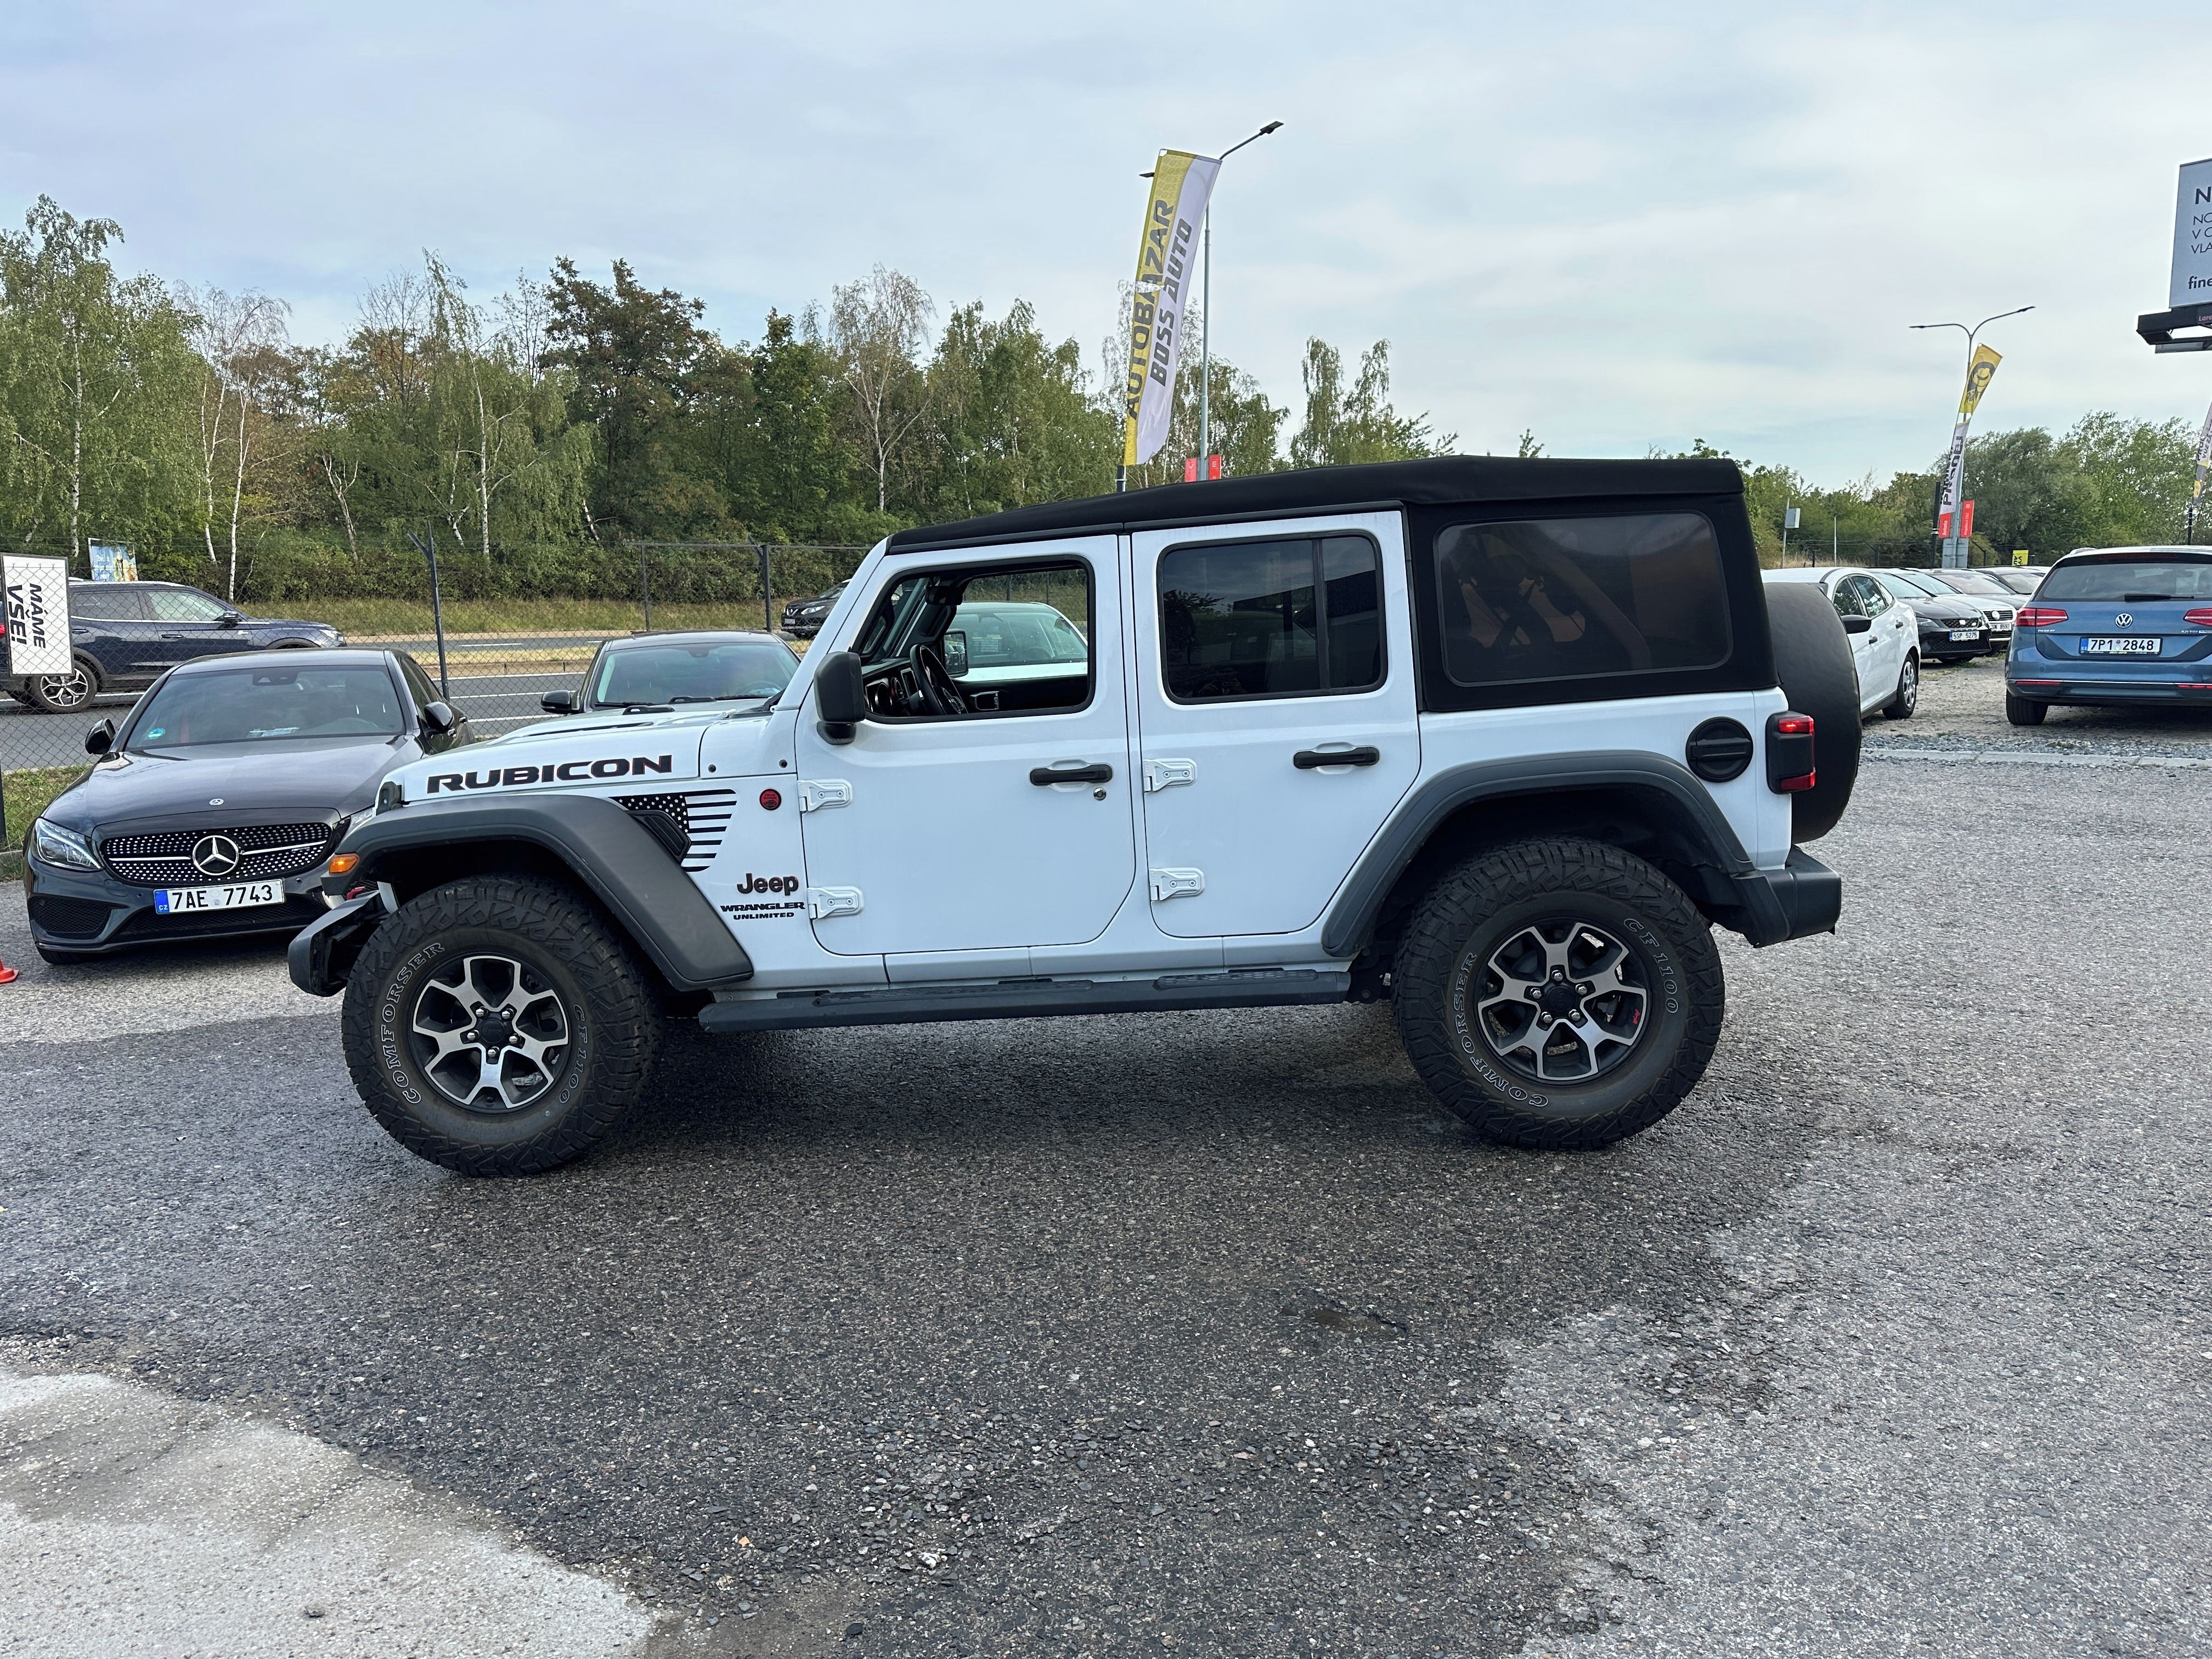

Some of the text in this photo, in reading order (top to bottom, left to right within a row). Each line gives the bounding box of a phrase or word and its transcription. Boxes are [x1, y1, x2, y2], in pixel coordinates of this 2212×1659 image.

[2192, 229, 2201, 240] V
[1127, 200, 1174, 420] AUTOBAZAR
[1150, 218, 1192, 387] BOSS AUTO
[7, 584, 31, 645] VŠE!
[30, 583, 48, 649] MÁME
[2091, 639, 2154, 651] 7P1 2848
[426, 754, 673, 794] RUBICON
[172, 884, 273, 910] 7AE 7743
[736, 873, 799, 896] Jeep
[720, 901, 806, 912] WRANGLER
[733, 912, 794, 920] UNLIMITED
[381, 943, 445, 1104] COMFORSER
[1453, 952, 1549, 1108] COMFORSER
